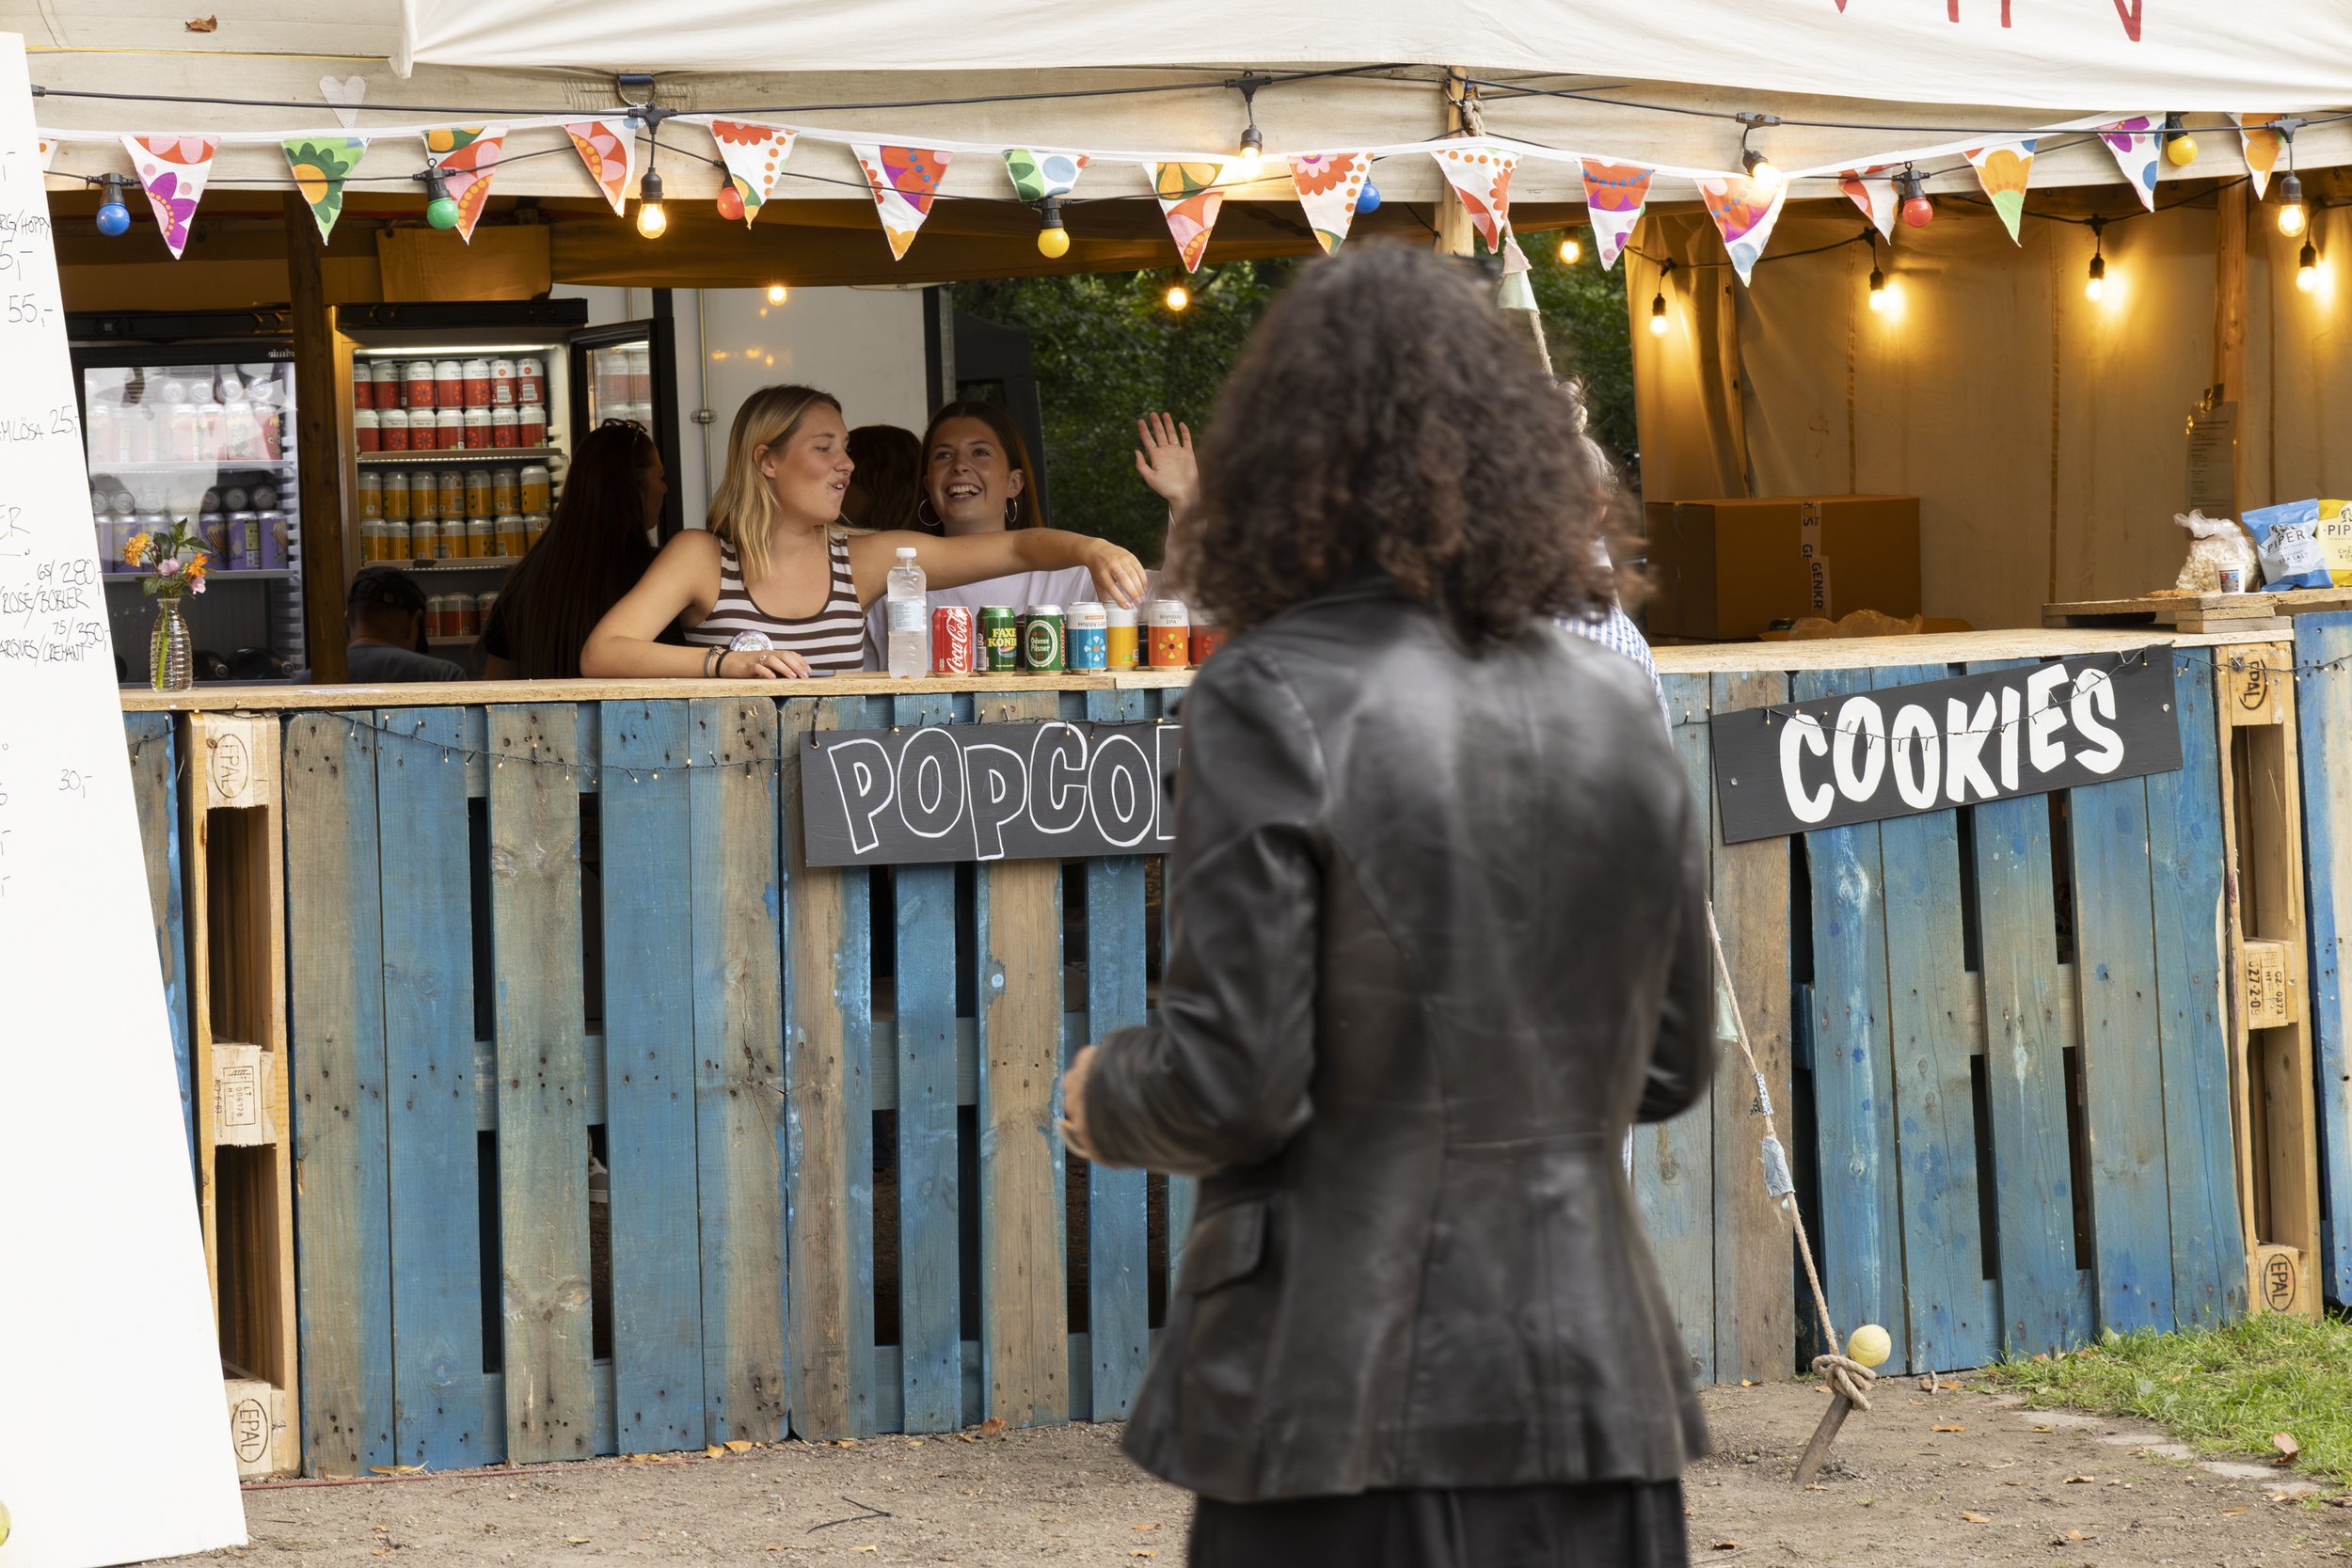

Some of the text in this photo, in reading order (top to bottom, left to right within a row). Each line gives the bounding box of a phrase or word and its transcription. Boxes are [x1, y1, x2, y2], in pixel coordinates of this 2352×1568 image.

[8, 293, 54, 327] 55,-
[1779, 662, 2125, 823] COOKIES
[219, 744, 241, 789] EPAL
[2270, 1261, 2289, 1304] EPAL
[239, 1409, 260, 1452] EPAL
